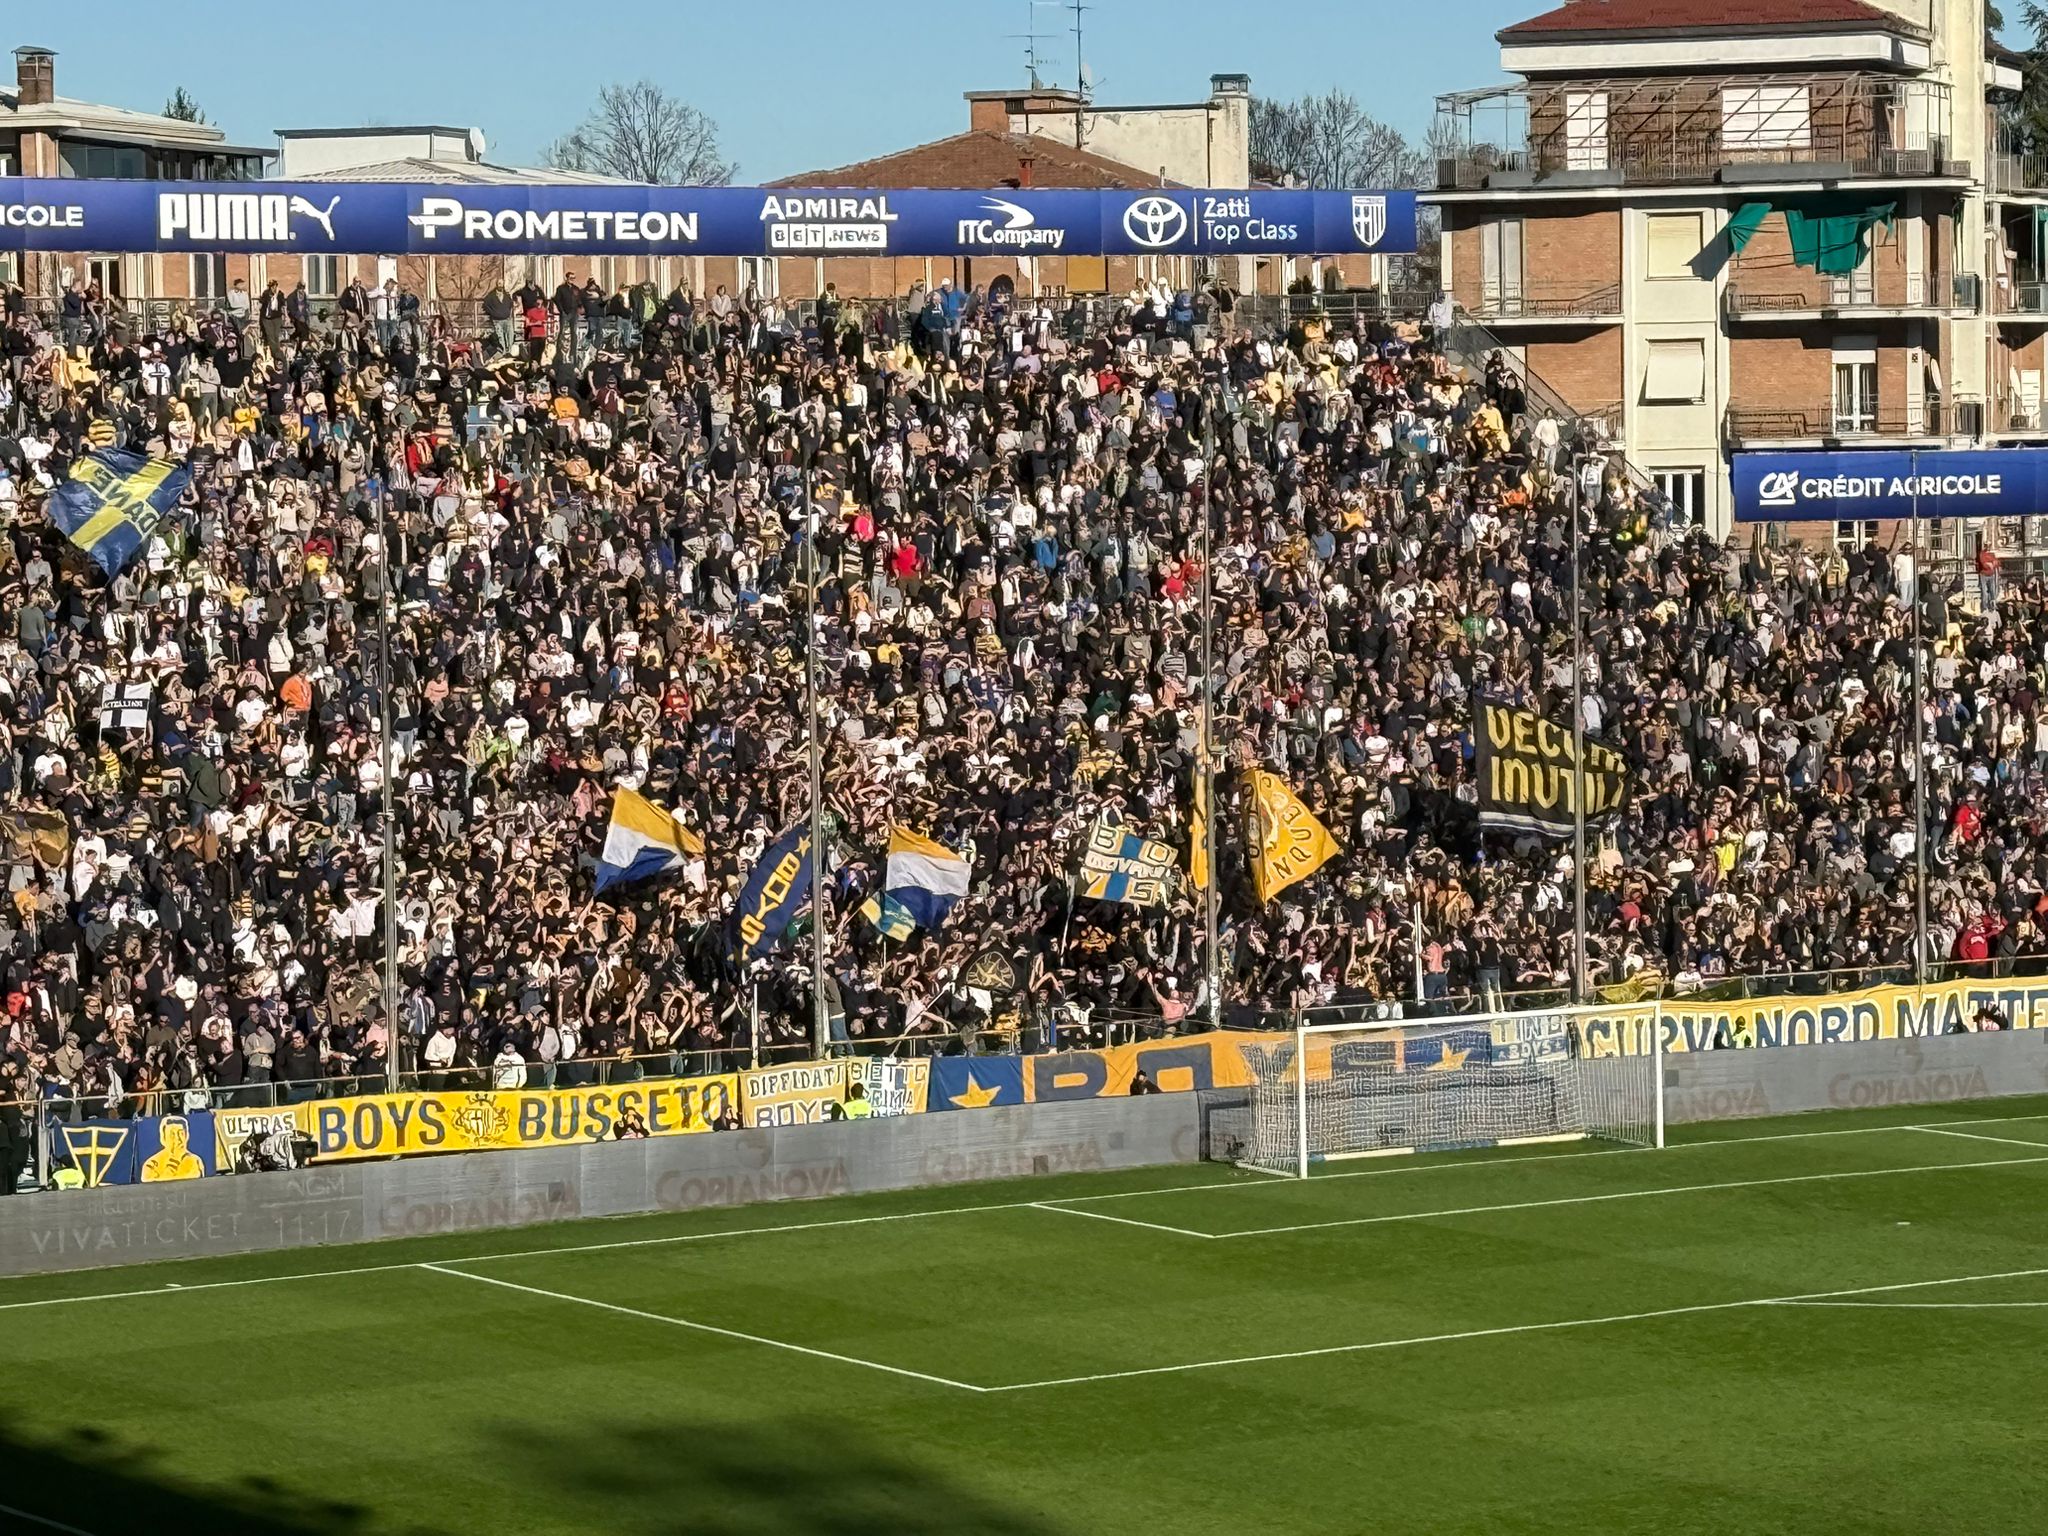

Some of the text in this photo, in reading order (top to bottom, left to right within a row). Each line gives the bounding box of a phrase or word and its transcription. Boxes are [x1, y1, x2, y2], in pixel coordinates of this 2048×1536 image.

[159, 194, 289, 240] PUMA
[408, 197, 700, 241] PROMETEON
[760, 195, 899, 221] ADMIRAL
[1203, 197, 1251, 217] Zatti
[1203, 218, 1299, 244] Top Class
[1802, 474, 1885, 499] CRÉDIT
[1888, 474, 2001, 497] AGRICOLE
[319, 1099, 446, 1152] BOYS
[519, 1080, 727, 1142] BUSSETO
